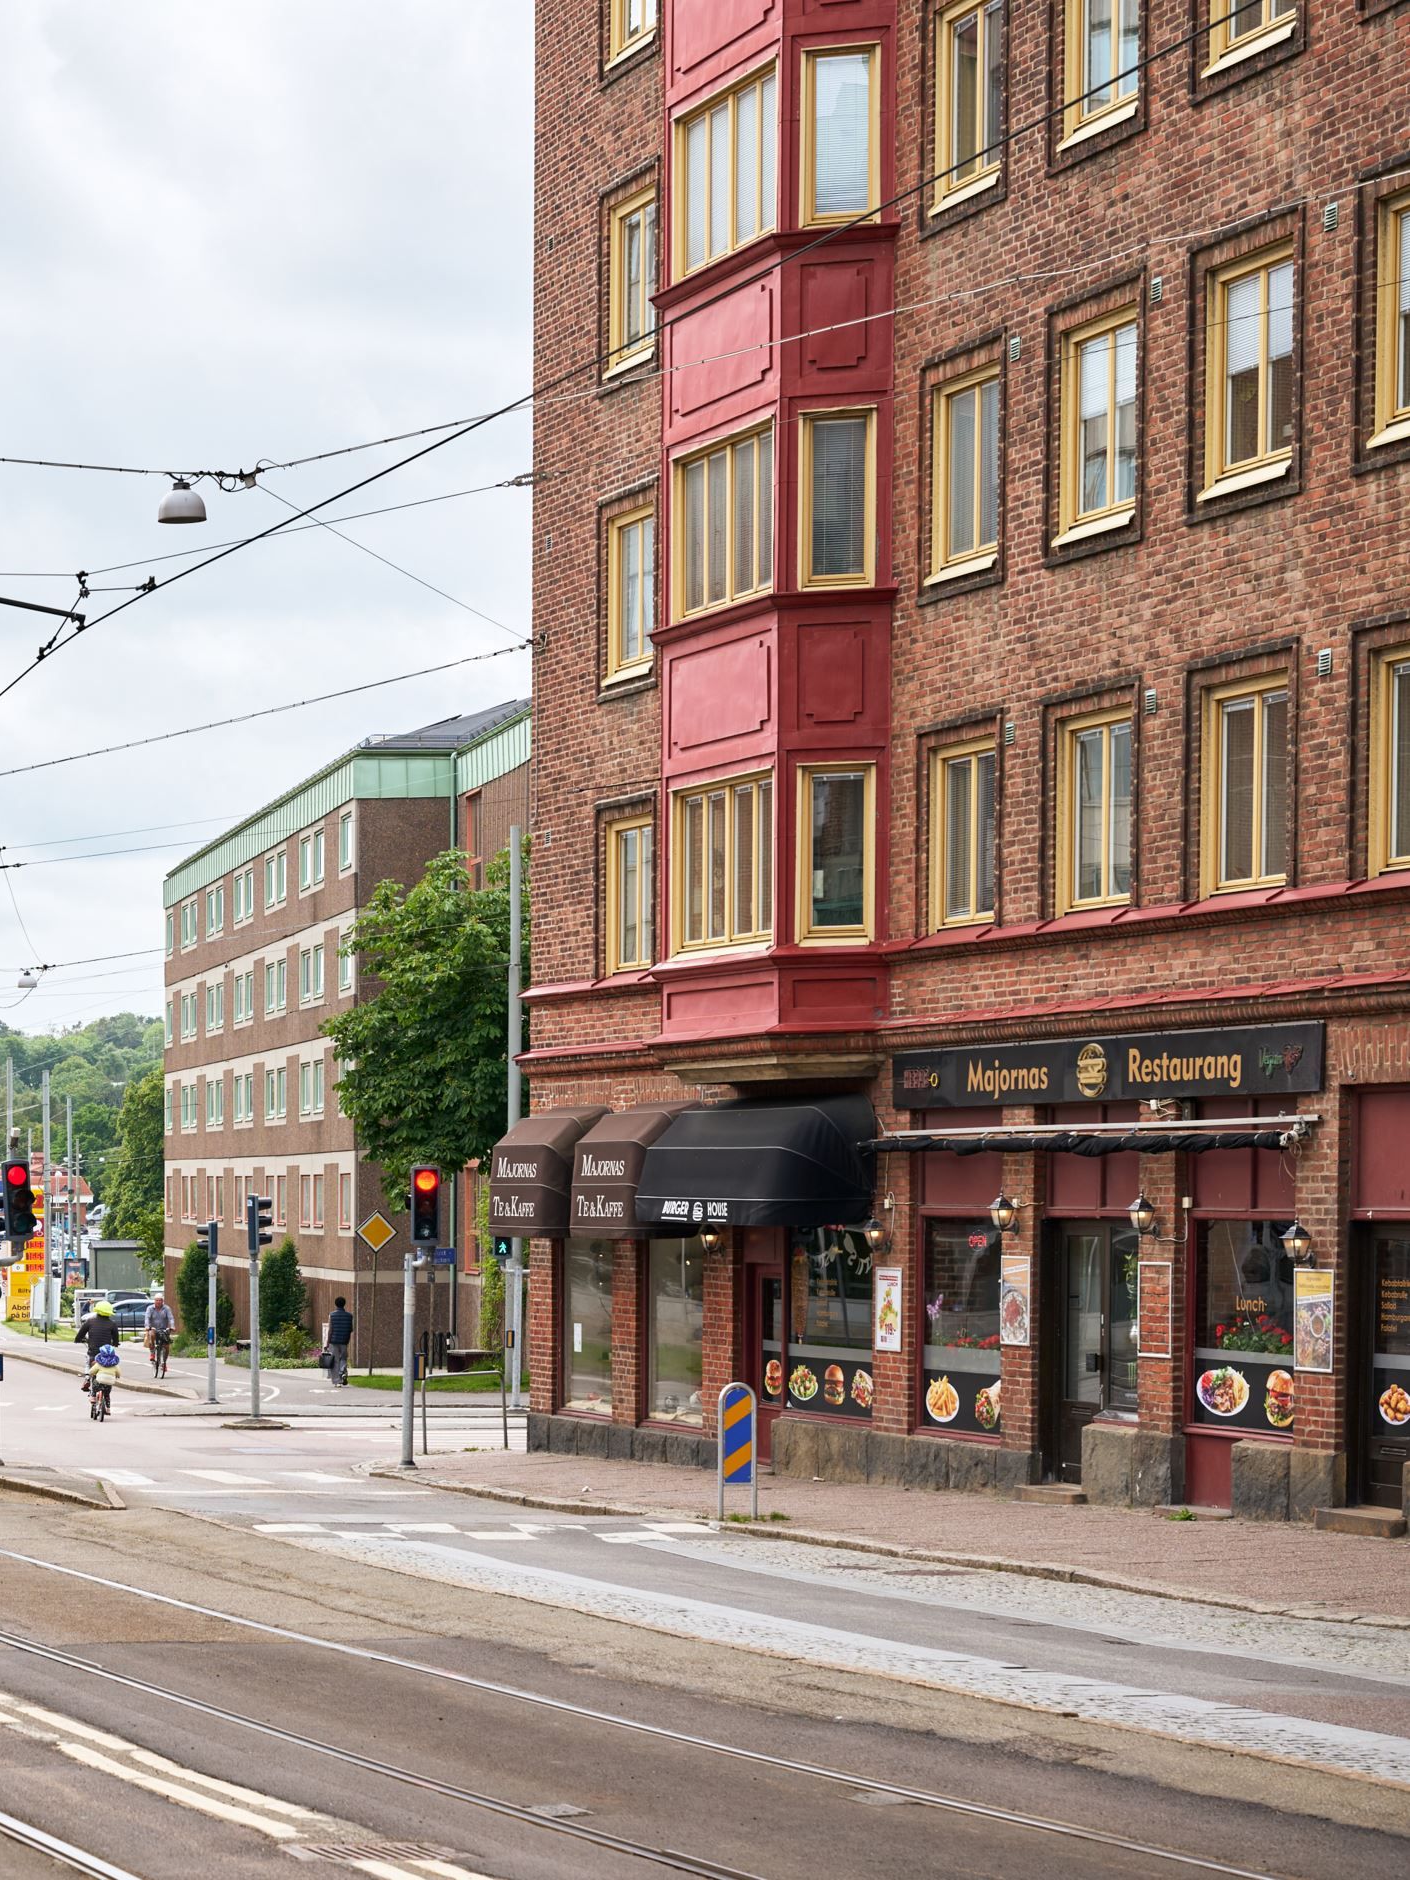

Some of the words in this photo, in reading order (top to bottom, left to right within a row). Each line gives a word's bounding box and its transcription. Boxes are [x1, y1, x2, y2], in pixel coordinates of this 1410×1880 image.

[967, 1059, 1048, 1100] Majornas
[1128, 1048, 1242, 1088] Restaurang
[496, 1157, 537, 1178] MAJORNAS
[581, 1154, 625, 1177] MAJORNAS
[661, 1200, 690, 1215] BURGER
[707, 1201, 728, 1217] HOUSE
[968, 1235, 987, 1247] OPEN
